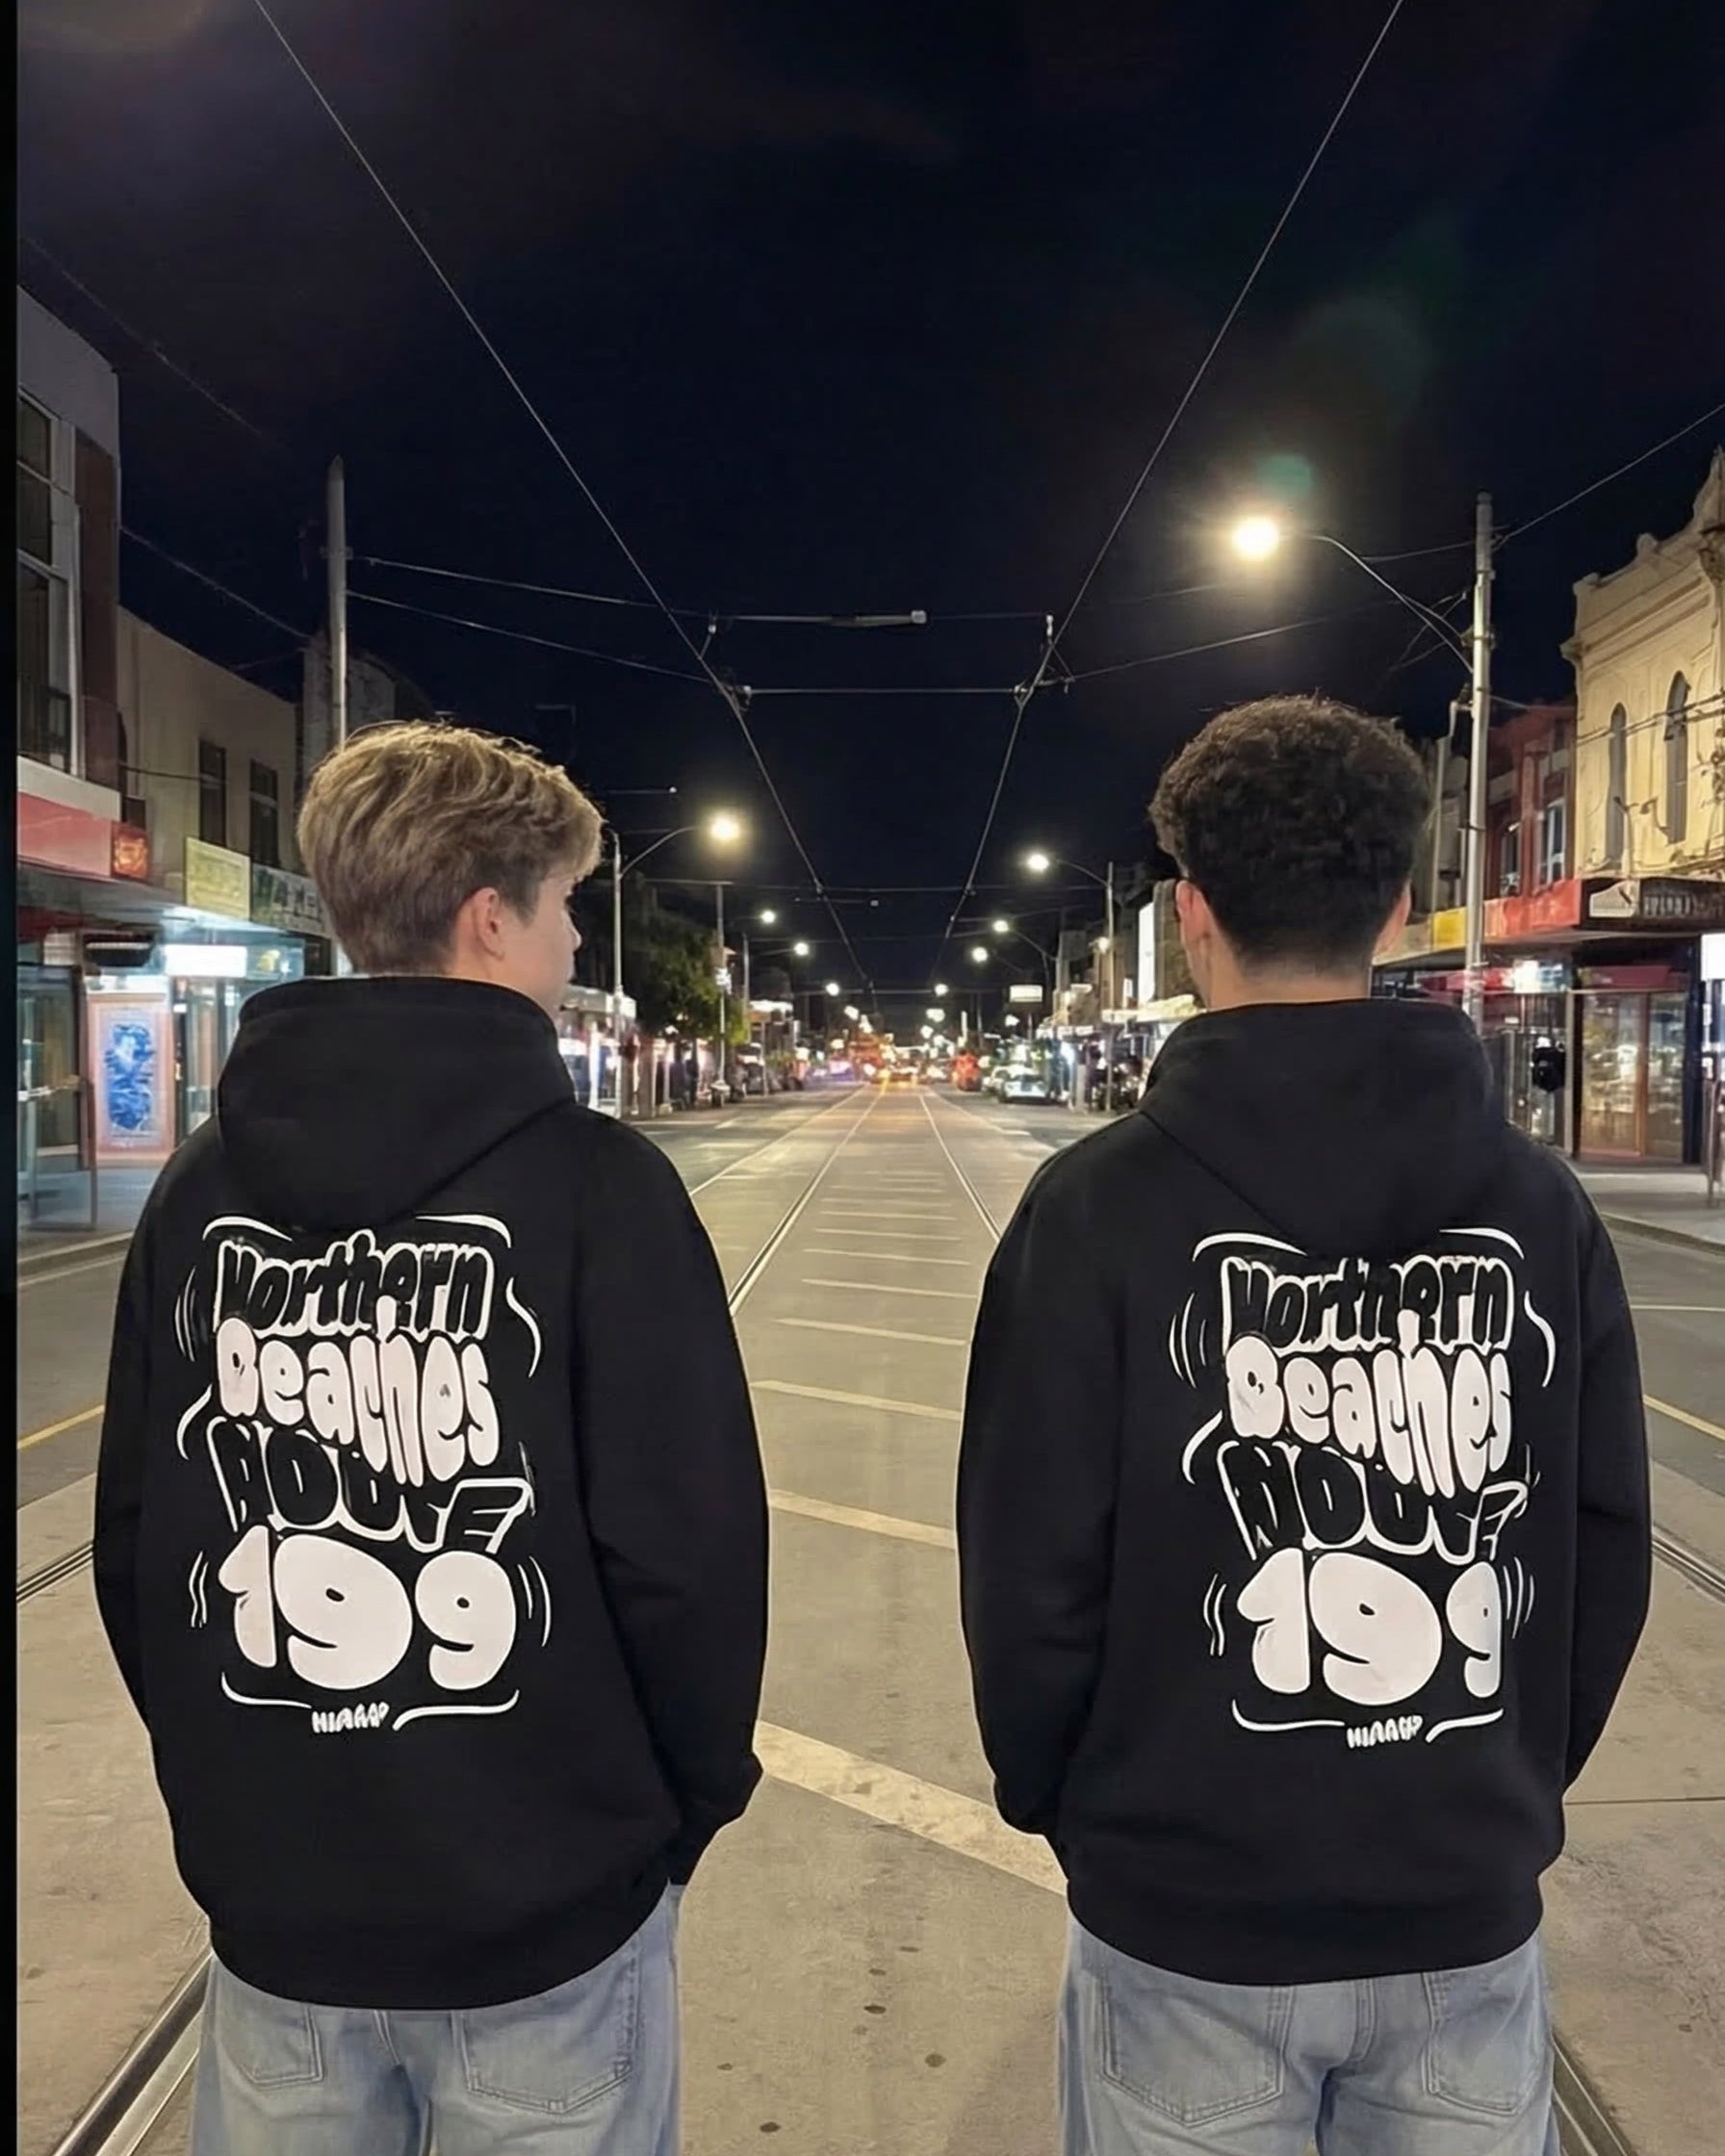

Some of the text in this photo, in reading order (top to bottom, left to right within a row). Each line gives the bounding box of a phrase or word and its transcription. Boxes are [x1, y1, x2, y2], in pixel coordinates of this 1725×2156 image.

[217, 1296, 500, 1487] Beaches
[1225, 1309, 1511, 1499] Beaches
[219, 1525, 517, 1690] 199
[1237, 1548, 1502, 1706] 199
